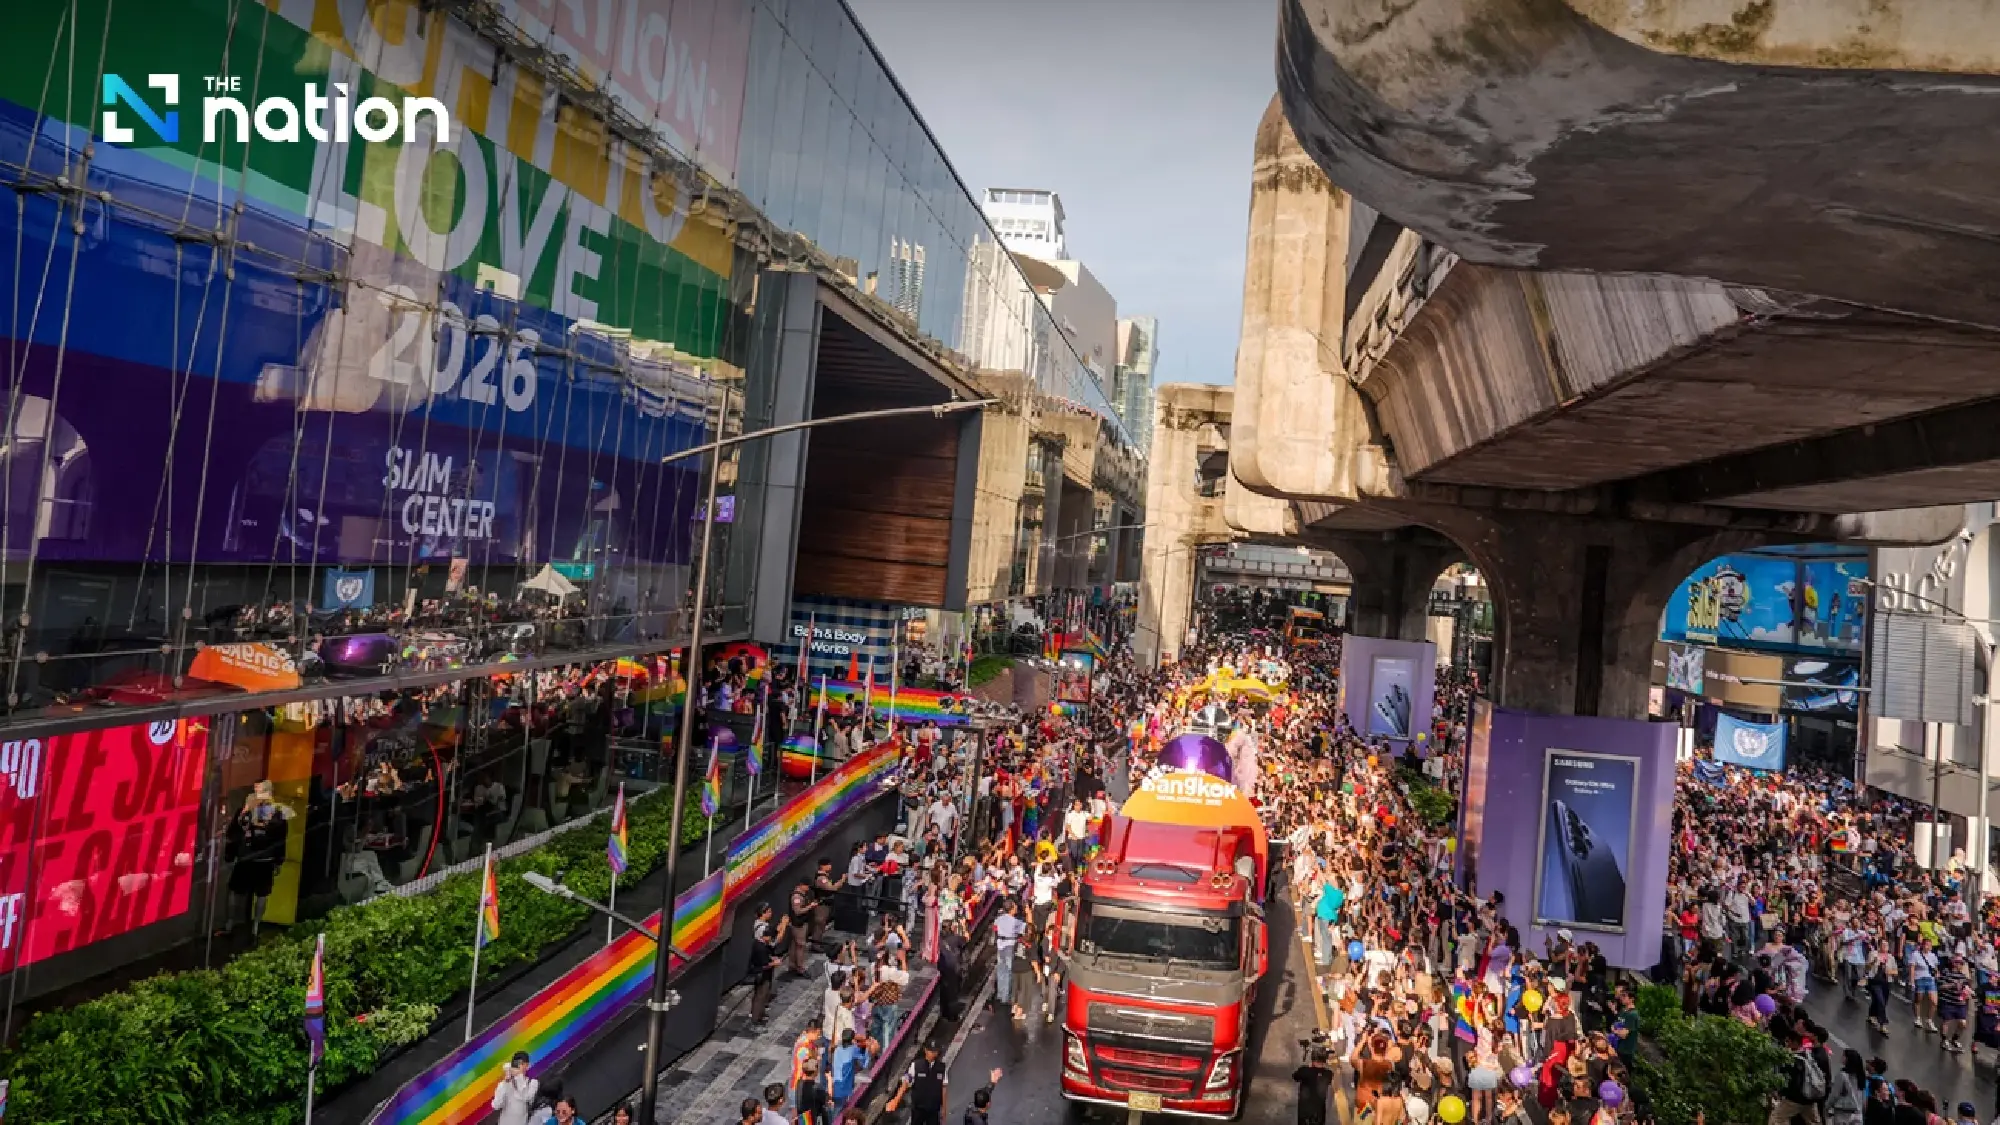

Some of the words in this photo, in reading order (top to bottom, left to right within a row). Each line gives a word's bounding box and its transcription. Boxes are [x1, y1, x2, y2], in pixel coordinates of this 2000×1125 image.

[306, 48, 611, 322] LOVE
[368, 284, 542, 413] 2026
[383, 446, 453, 491] SIAM
[402, 493, 497, 540] CENTER
[810, 641, 849, 655] Works
[825, 628, 833, 640] &
[834, 628, 867, 646] Body
[1141, 776, 1238, 800] Bangkok
